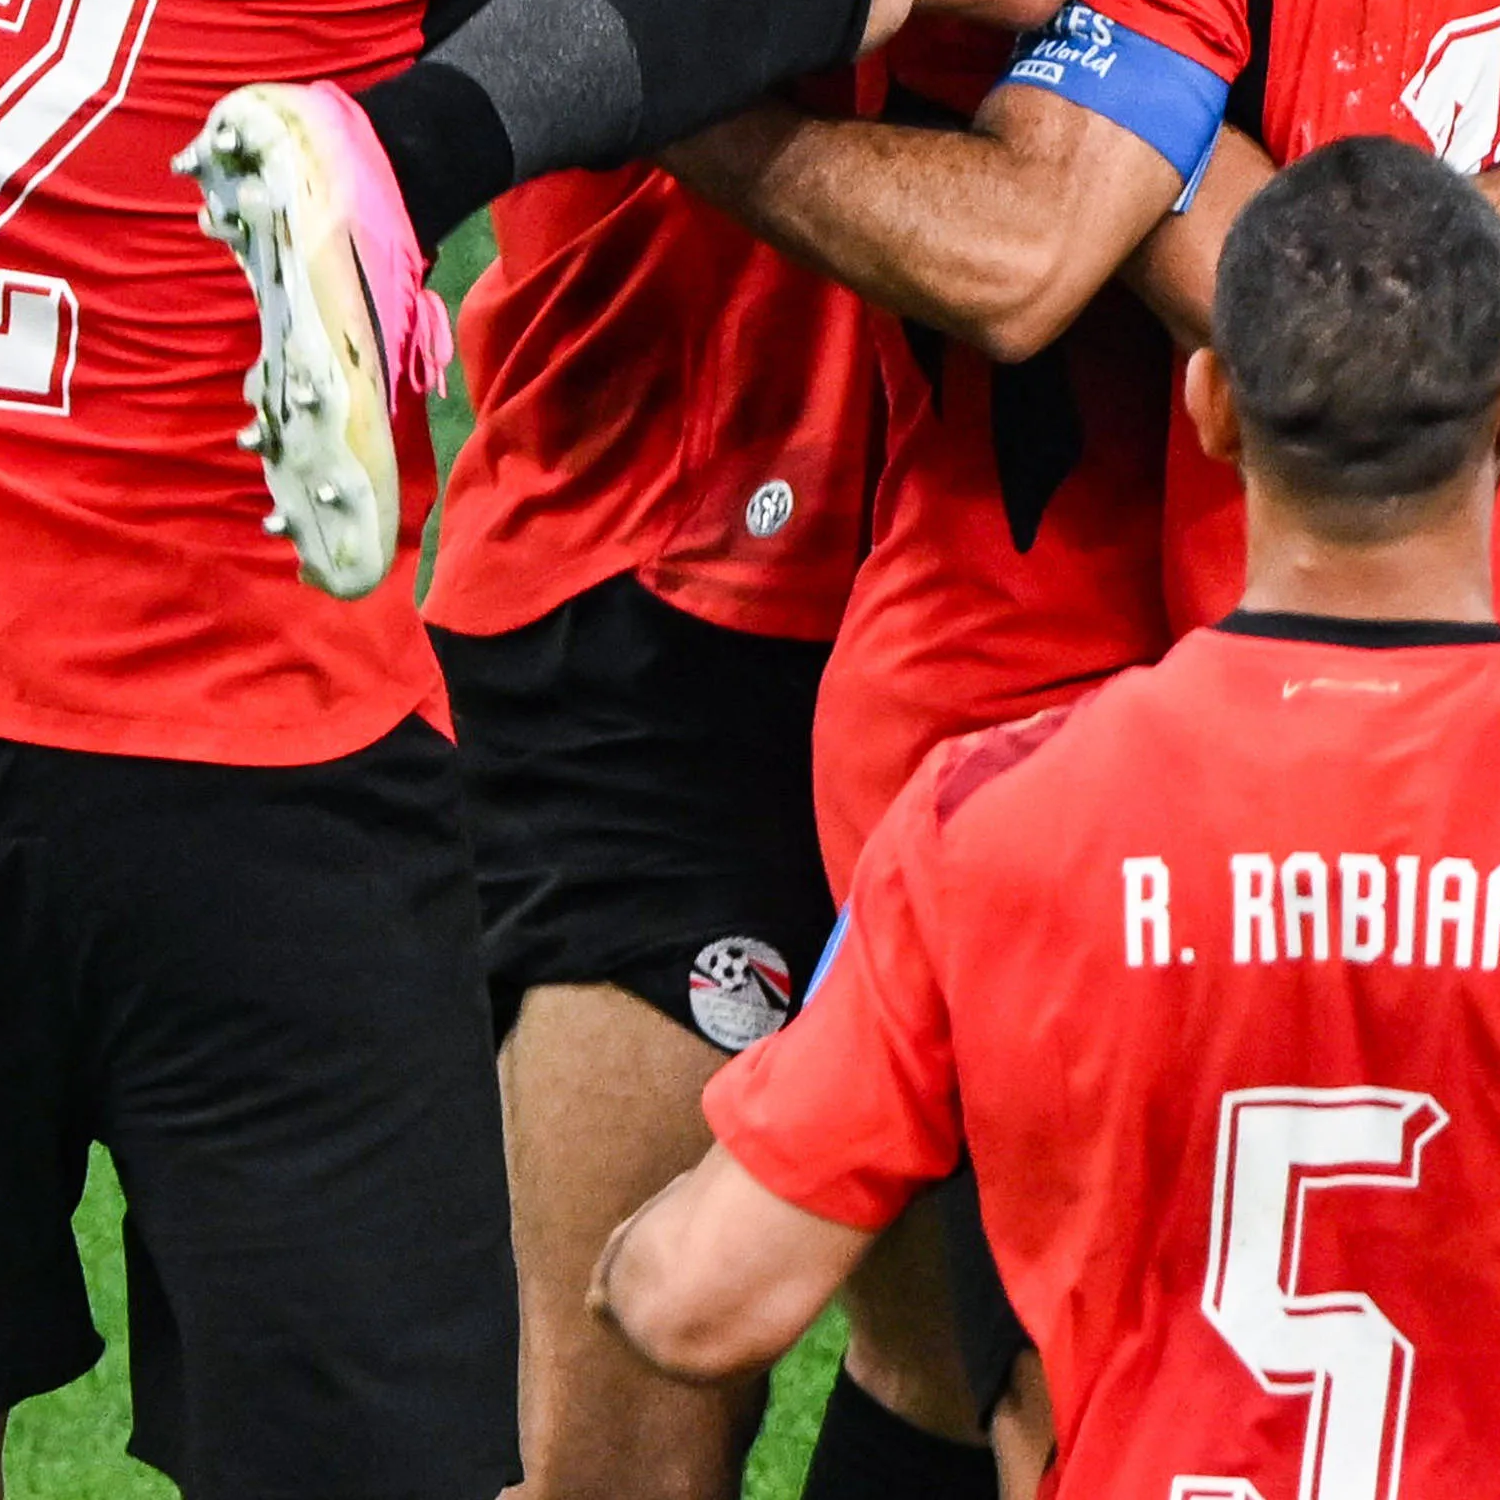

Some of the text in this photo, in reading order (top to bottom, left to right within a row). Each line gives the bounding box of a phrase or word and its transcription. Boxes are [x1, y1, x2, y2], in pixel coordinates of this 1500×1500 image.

[1012, 60, 1060, 81] FIFA
[1031, 38, 1118, 79] World
[1122, 855, 1196, 968] R.
[1168, 1085, 1450, 1500] 5
